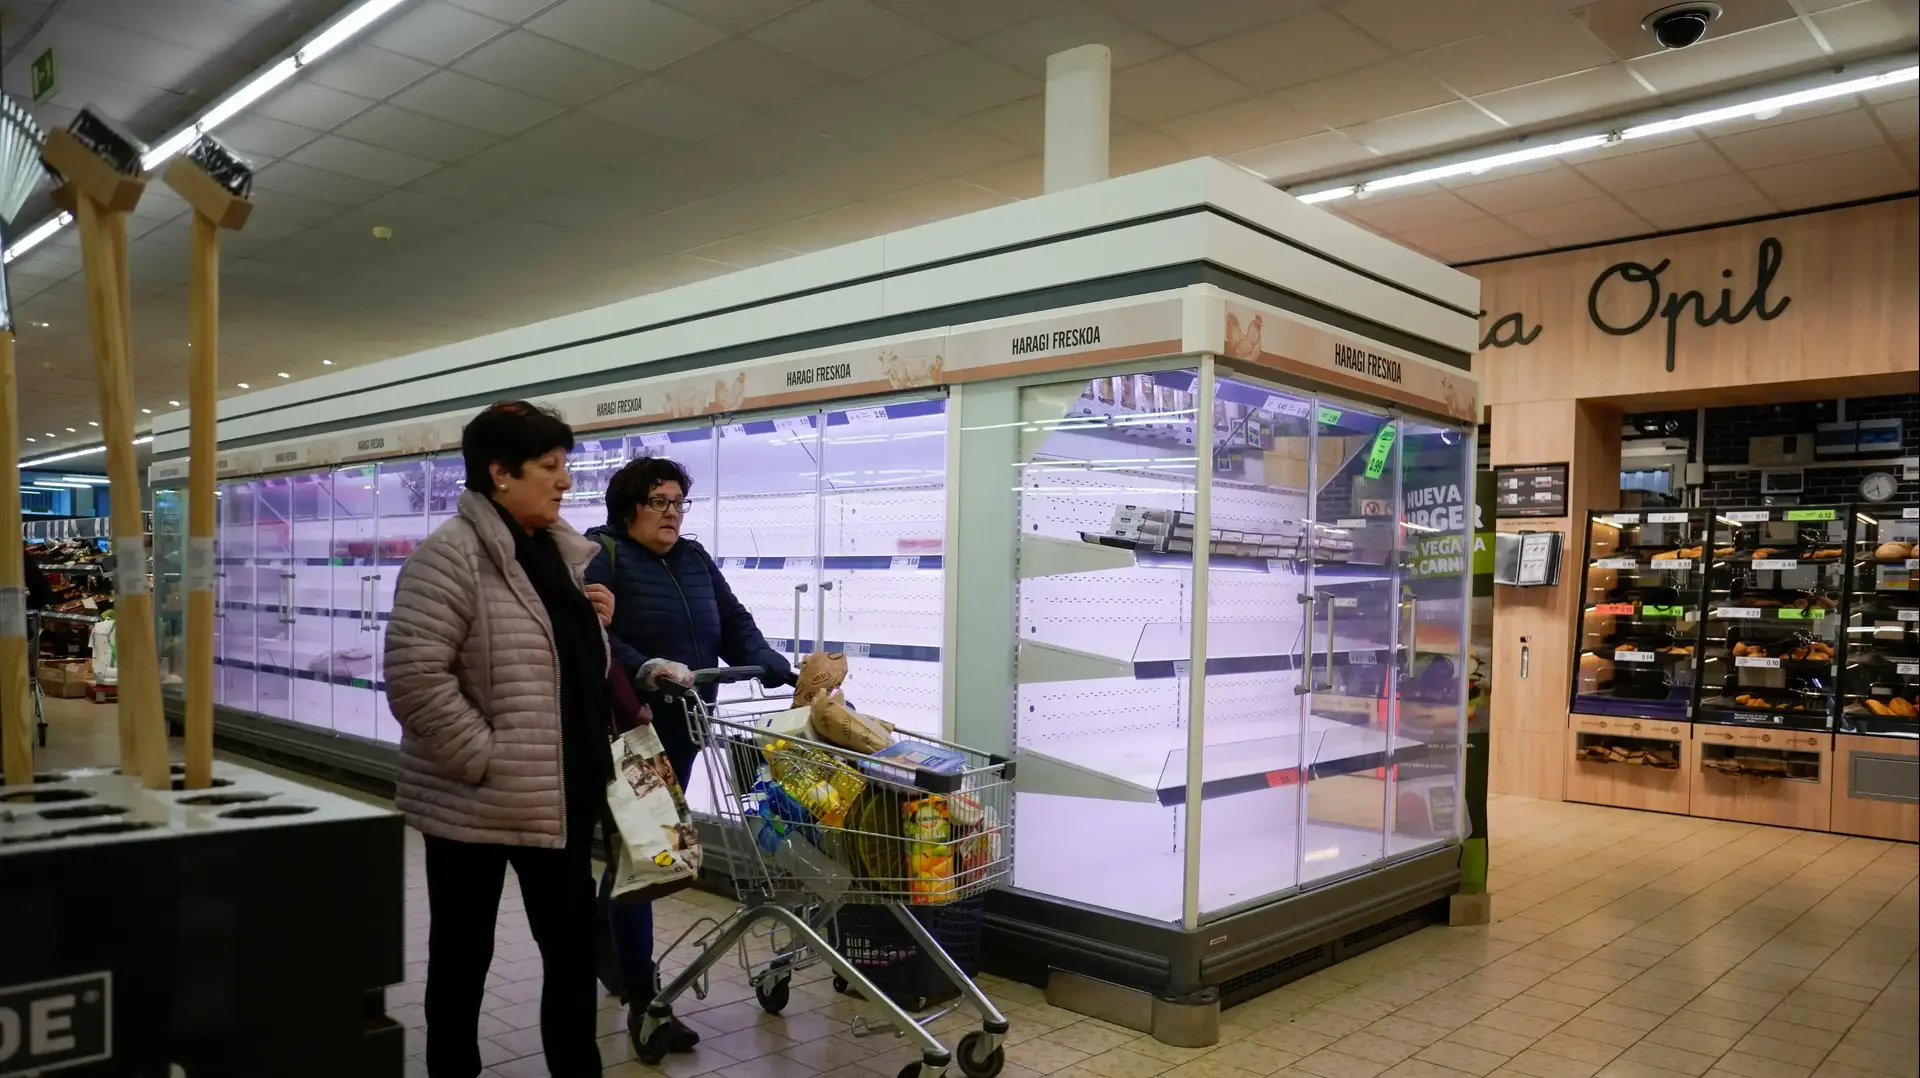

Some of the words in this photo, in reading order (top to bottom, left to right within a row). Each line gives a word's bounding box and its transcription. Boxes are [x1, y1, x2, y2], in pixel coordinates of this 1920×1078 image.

[1587, 237, 1792, 373] Opil
[1012, 333, 1049, 355] HARAGI
[1052, 325, 1101, 350] FRESKOA
[786, 368, 814, 387] HARAGI
[816, 363, 851, 382] FRESKOA
[1334, 342, 1366, 373] HARAGI
[1367, 353, 1402, 384] FRESKOA
[596, 401, 617, 417] HARAGI
[617, 397, 642, 414] FRESKOA
[1407, 484, 1462, 508] NUEVA
[1407, 503, 1484, 537] URGER
[1420, 537, 1487, 556] VEGAA
